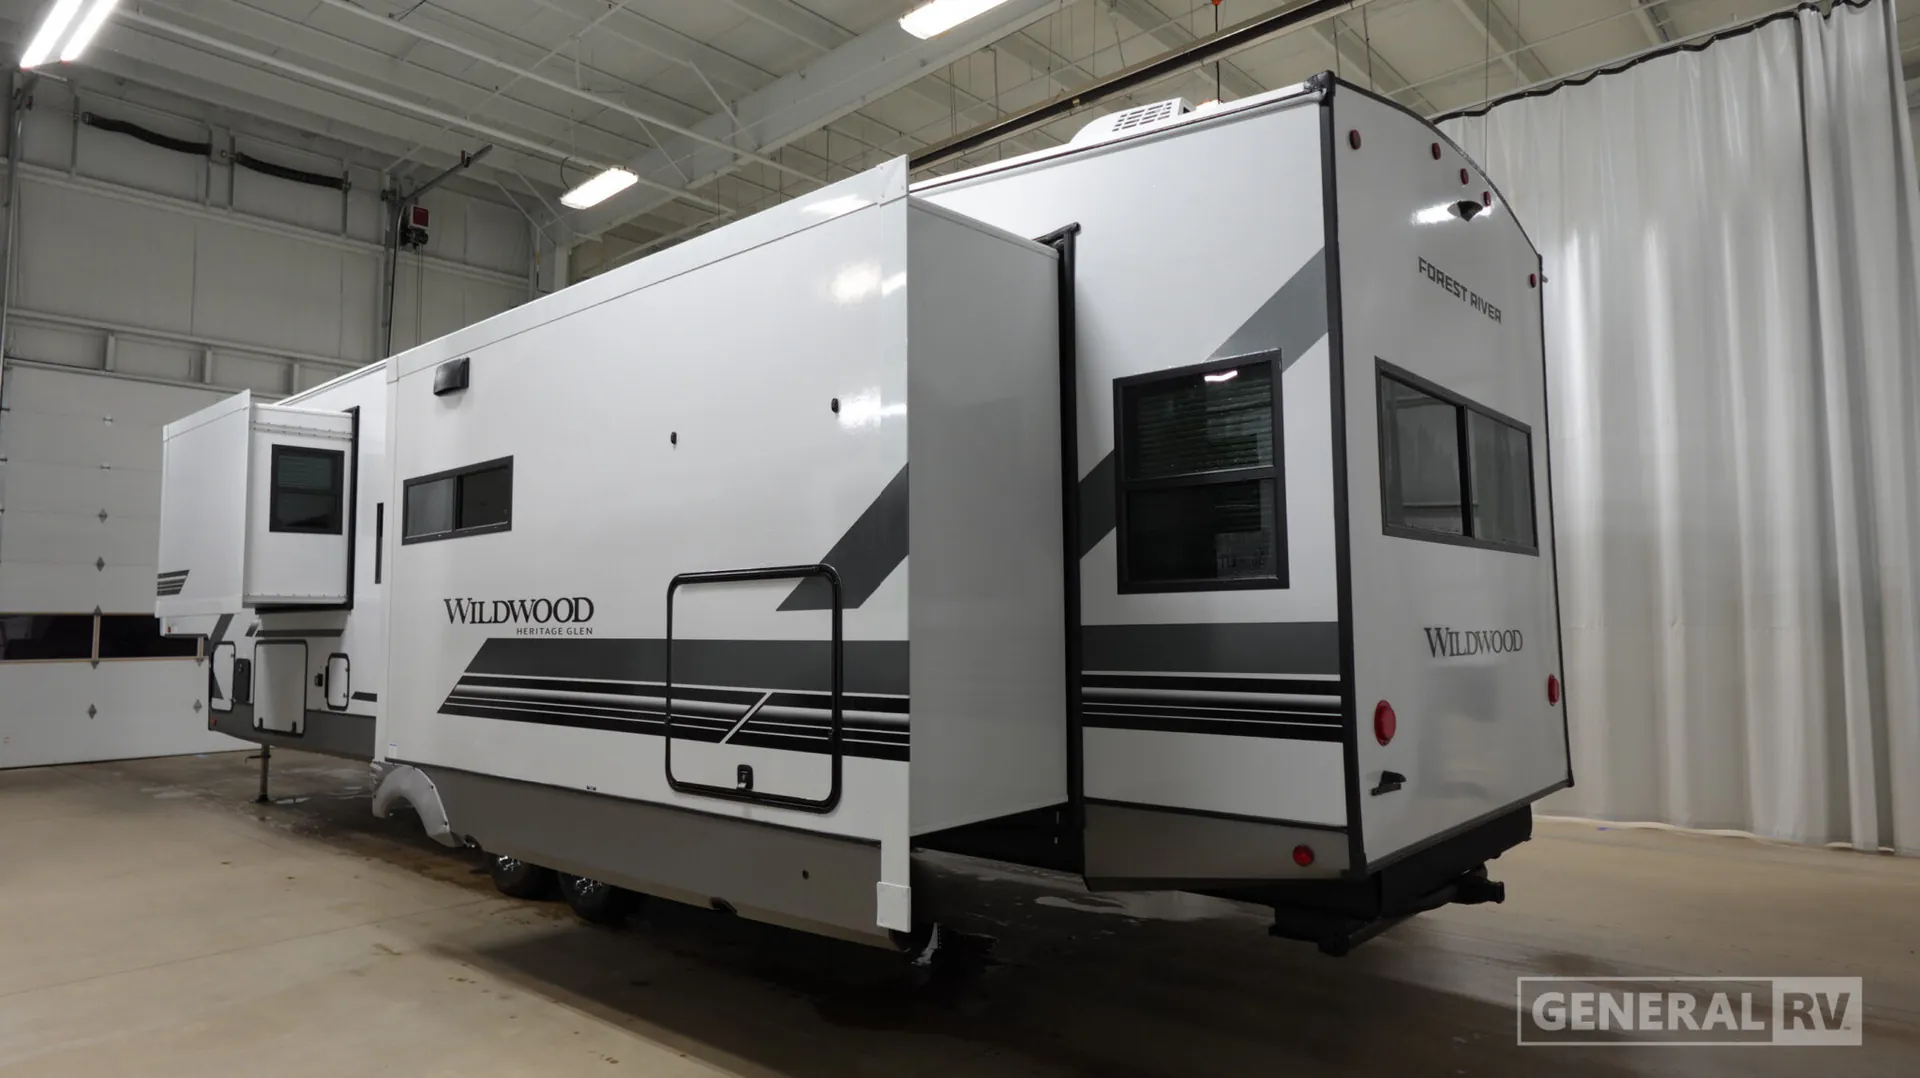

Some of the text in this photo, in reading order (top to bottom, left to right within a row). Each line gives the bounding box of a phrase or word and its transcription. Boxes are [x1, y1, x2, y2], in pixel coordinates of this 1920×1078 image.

[1418, 256, 1502, 325] FOREST RIVER
[443, 597, 595, 624] WILDWOOD
[516, 627, 593, 636] HERITAGE GLEN
[1423, 627, 1523, 658] WILDWOOD
